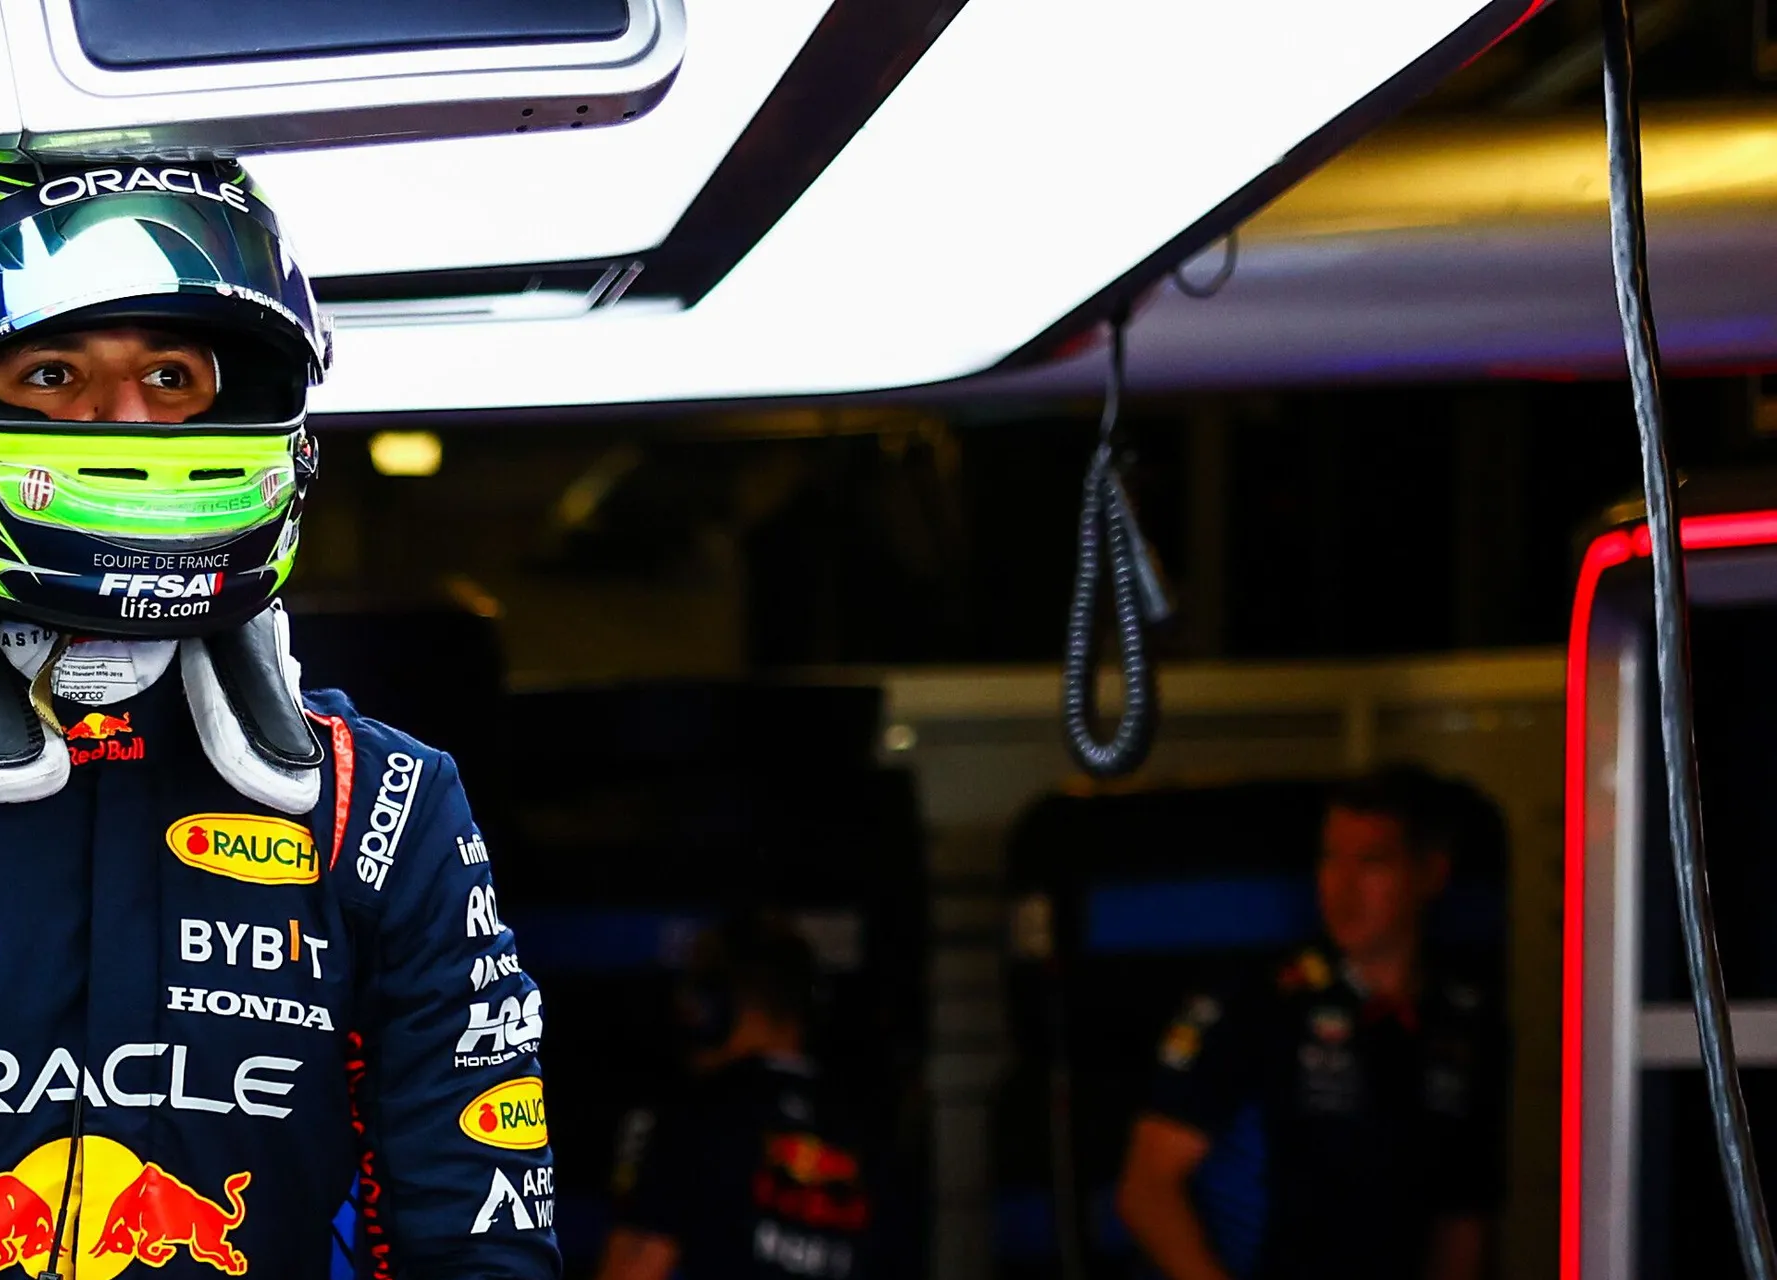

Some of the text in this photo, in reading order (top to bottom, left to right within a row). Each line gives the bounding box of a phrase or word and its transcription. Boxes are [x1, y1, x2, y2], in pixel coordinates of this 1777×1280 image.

[39, 166, 250, 214] ORACLE
[93, 553, 229, 569] EQUIPE DE FRANCE
[98, 573, 214, 597] FFSA
[120, 597, 210, 618] lif3.com
[107, 737, 145, 761] Bull
[357, 752, 422, 890] sparco
[212, 829, 317, 873] RAUCH
[180, 918, 328, 979] BYBIT
[167, 986, 335, 1032] HONDA
